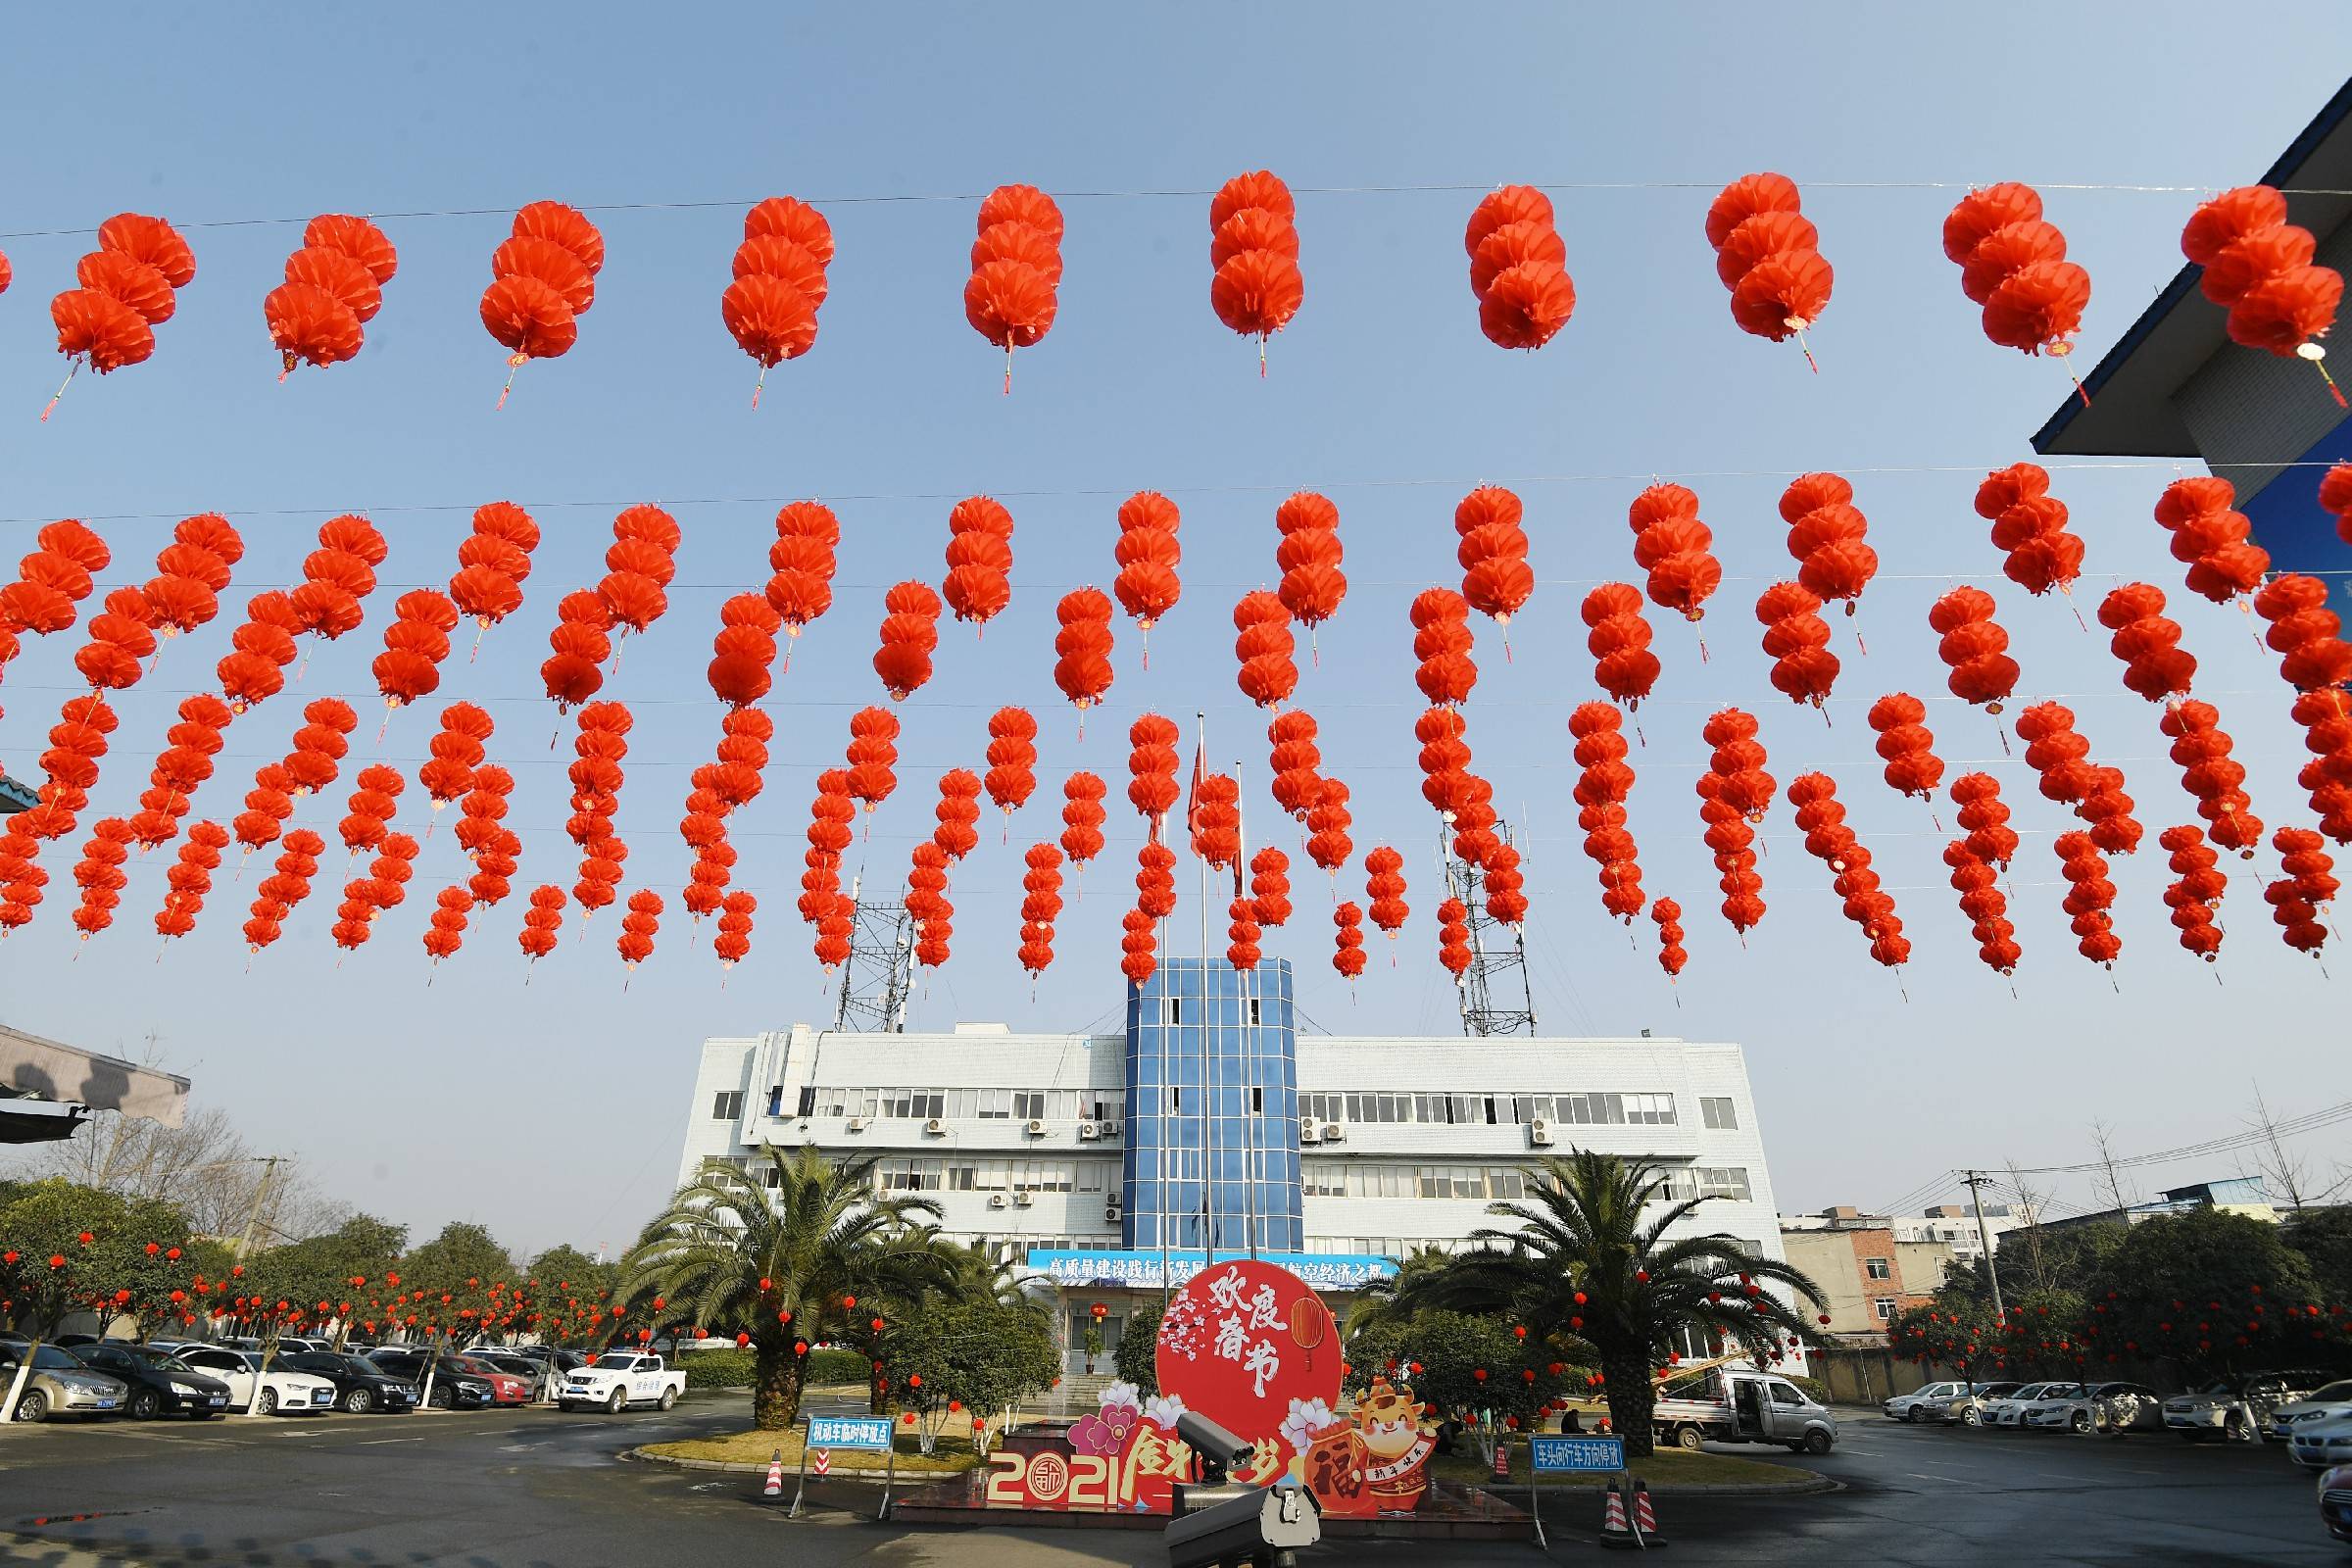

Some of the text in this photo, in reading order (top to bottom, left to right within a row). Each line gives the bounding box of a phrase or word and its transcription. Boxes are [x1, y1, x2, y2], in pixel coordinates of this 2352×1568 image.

[813, 1422, 887, 1444] 机动车临时停放点
[1120, 1425, 1279, 1502] 金牛岁
[1313, 1441, 1360, 1498] 福
[1374, 1447, 1424, 1479] 新年快乐
[1537, 1443, 1619, 1467] 车头向行车方向停放
[987, 1451, 1119, 1505] 2021
